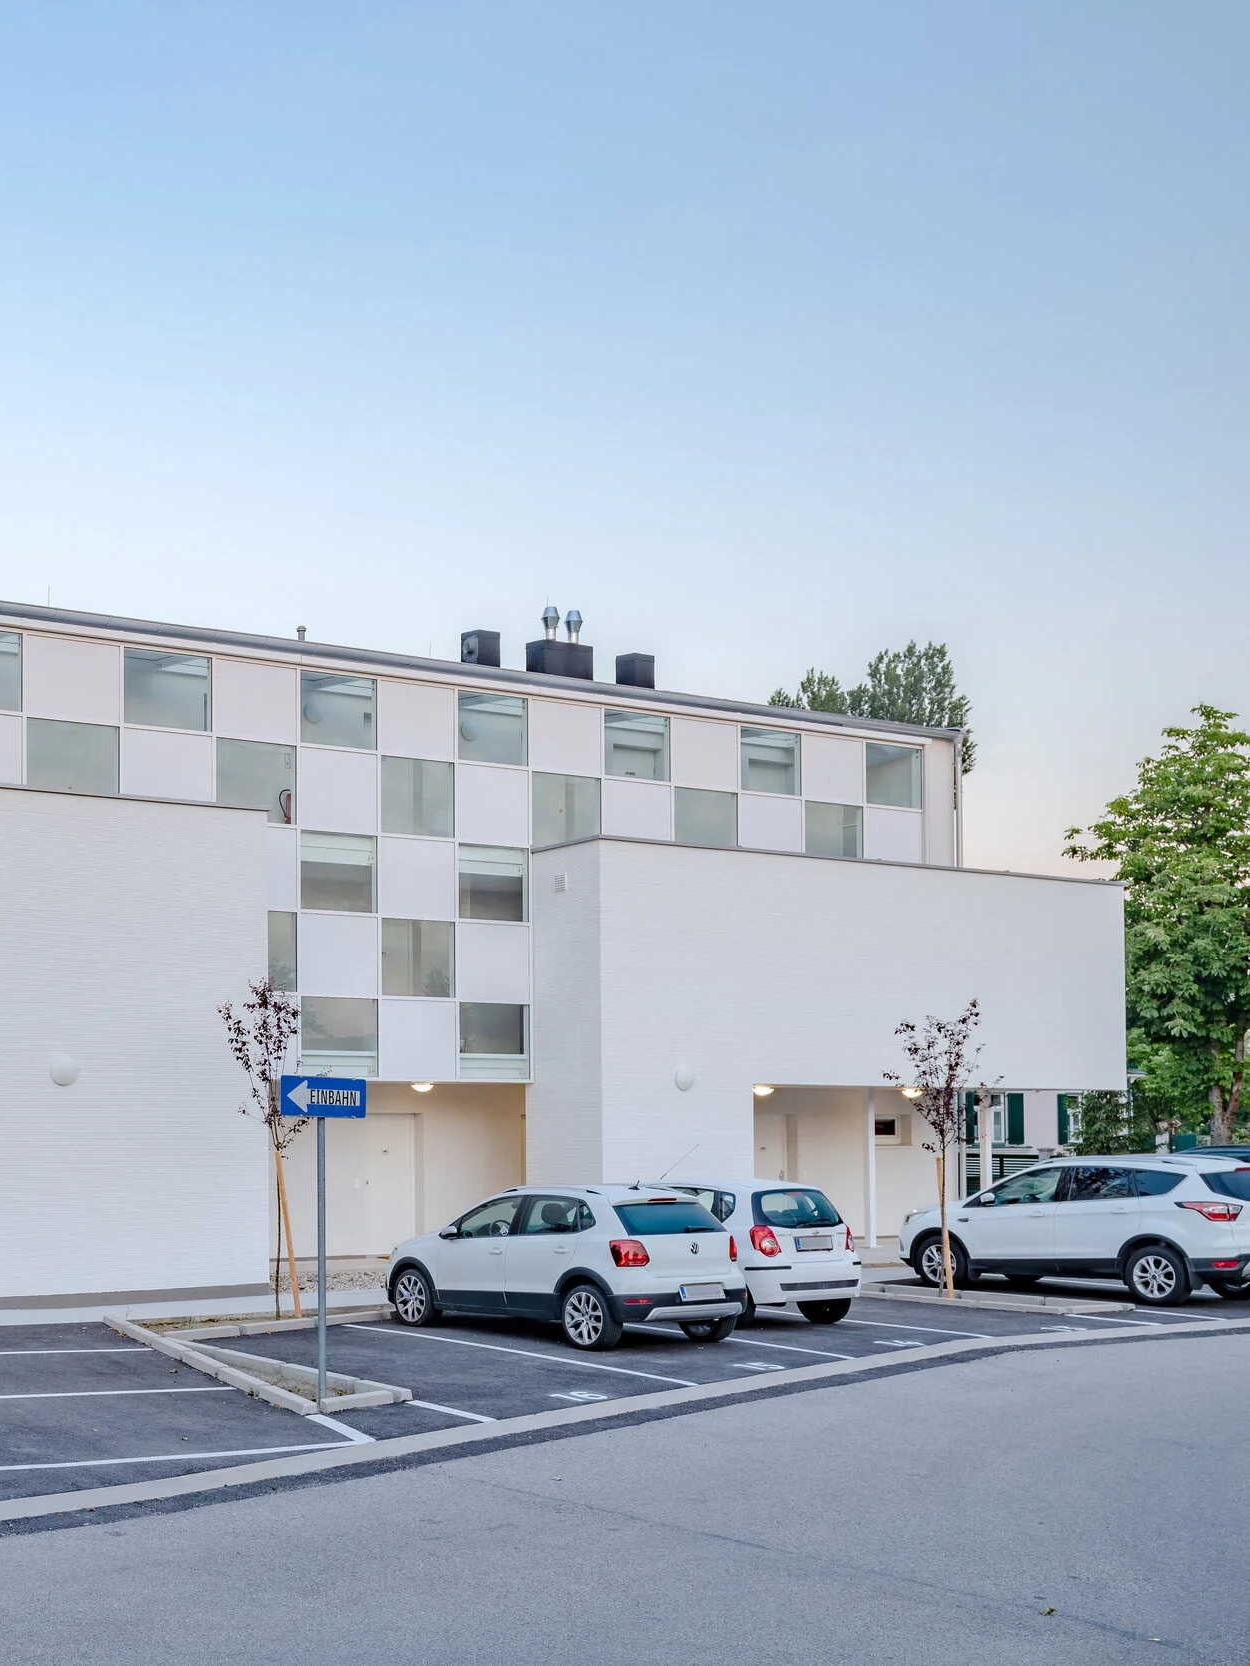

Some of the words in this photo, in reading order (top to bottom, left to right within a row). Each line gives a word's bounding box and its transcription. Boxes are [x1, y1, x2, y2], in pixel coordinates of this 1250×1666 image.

[310, 1089, 357, 1106] EINBAHN
[732, 1361, 785, 1371] 15
[549, 1391, 608, 1402] 16
